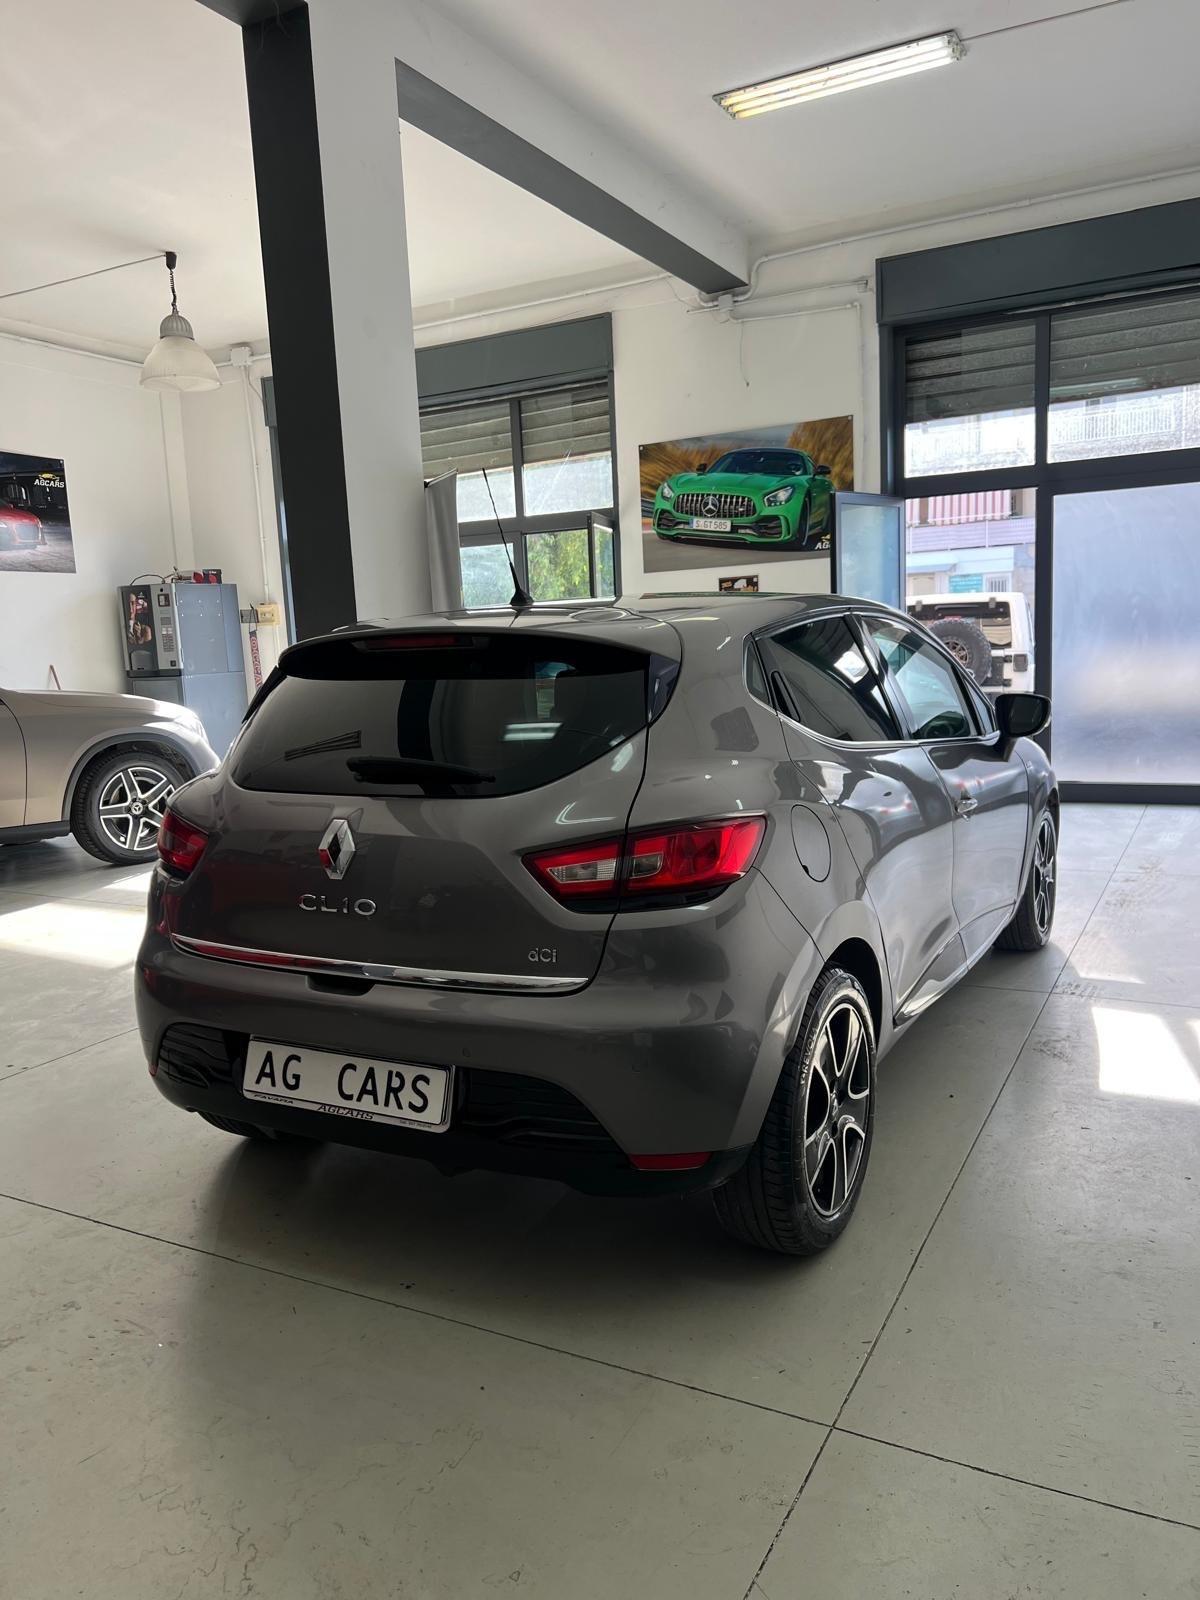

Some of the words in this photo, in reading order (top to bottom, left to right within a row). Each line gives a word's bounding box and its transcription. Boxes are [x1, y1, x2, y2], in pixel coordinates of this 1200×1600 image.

[34, 478, 65, 488] AGCARS
[814, 541, 830, 550] AG
[298, 894, 377, 916] CLIO
[528, 947, 558, 963] dCi
[255, 1050, 303, 1091] AG
[337, 1063, 431, 1114] CARS
